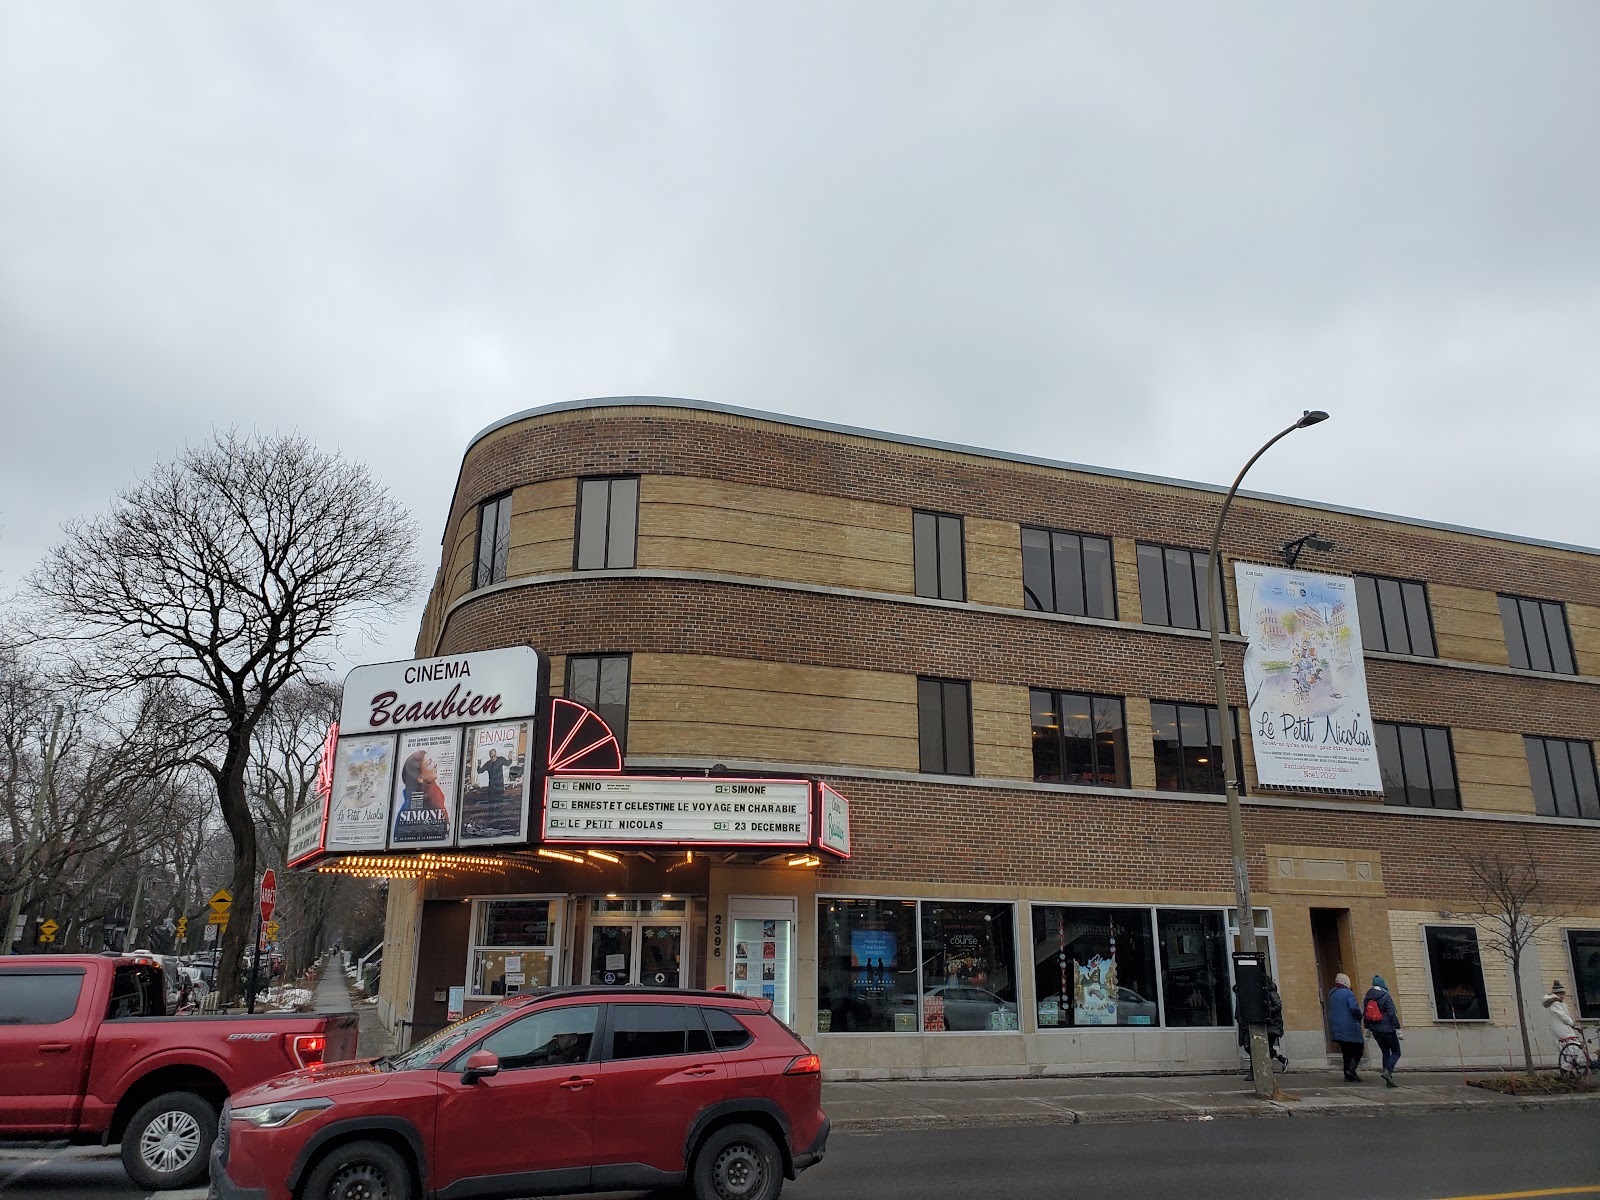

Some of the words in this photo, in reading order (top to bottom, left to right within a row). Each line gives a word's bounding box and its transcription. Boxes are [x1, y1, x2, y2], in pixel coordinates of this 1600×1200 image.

[404, 659, 471, 684] CINÉMA
[369, 683, 503, 727] Beaubien
[1256, 711, 1275, 739] Le
[1280, 712, 1315, 742] Petit
[1322, 715, 1371, 746] Nicolas
[480, 728, 515, 743] ENNIO
[1320, 772, 1337, 780] 2022
[573, 782, 602, 791] ENNIO
[731, 785, 766, 795] SIMONE
[571, 801, 609, 810] ERNEST
[609, 802, 622, 810] ET
[624, 801, 675, 811] CELESTINE
[678, 802, 689, 811] LE
[692, 802, 732, 812] VOYAGE
[734, 804, 746, 812] EN
[747, 804, 797, 814] CHARABIE
[400, 808, 446, 821] SIMONE
[568, 820, 580, 828] LE
[586, 820, 613, 829] PETIT
[619, 821, 663, 830] NICOLAS
[734, 822, 747, 831] 23
[751, 823, 801, 832] DECEMBRE
[262, 886, 276, 904] ARRÊT
[714, 914, 722, 958] 2396
[226, 1032, 278, 1042] SPORT
